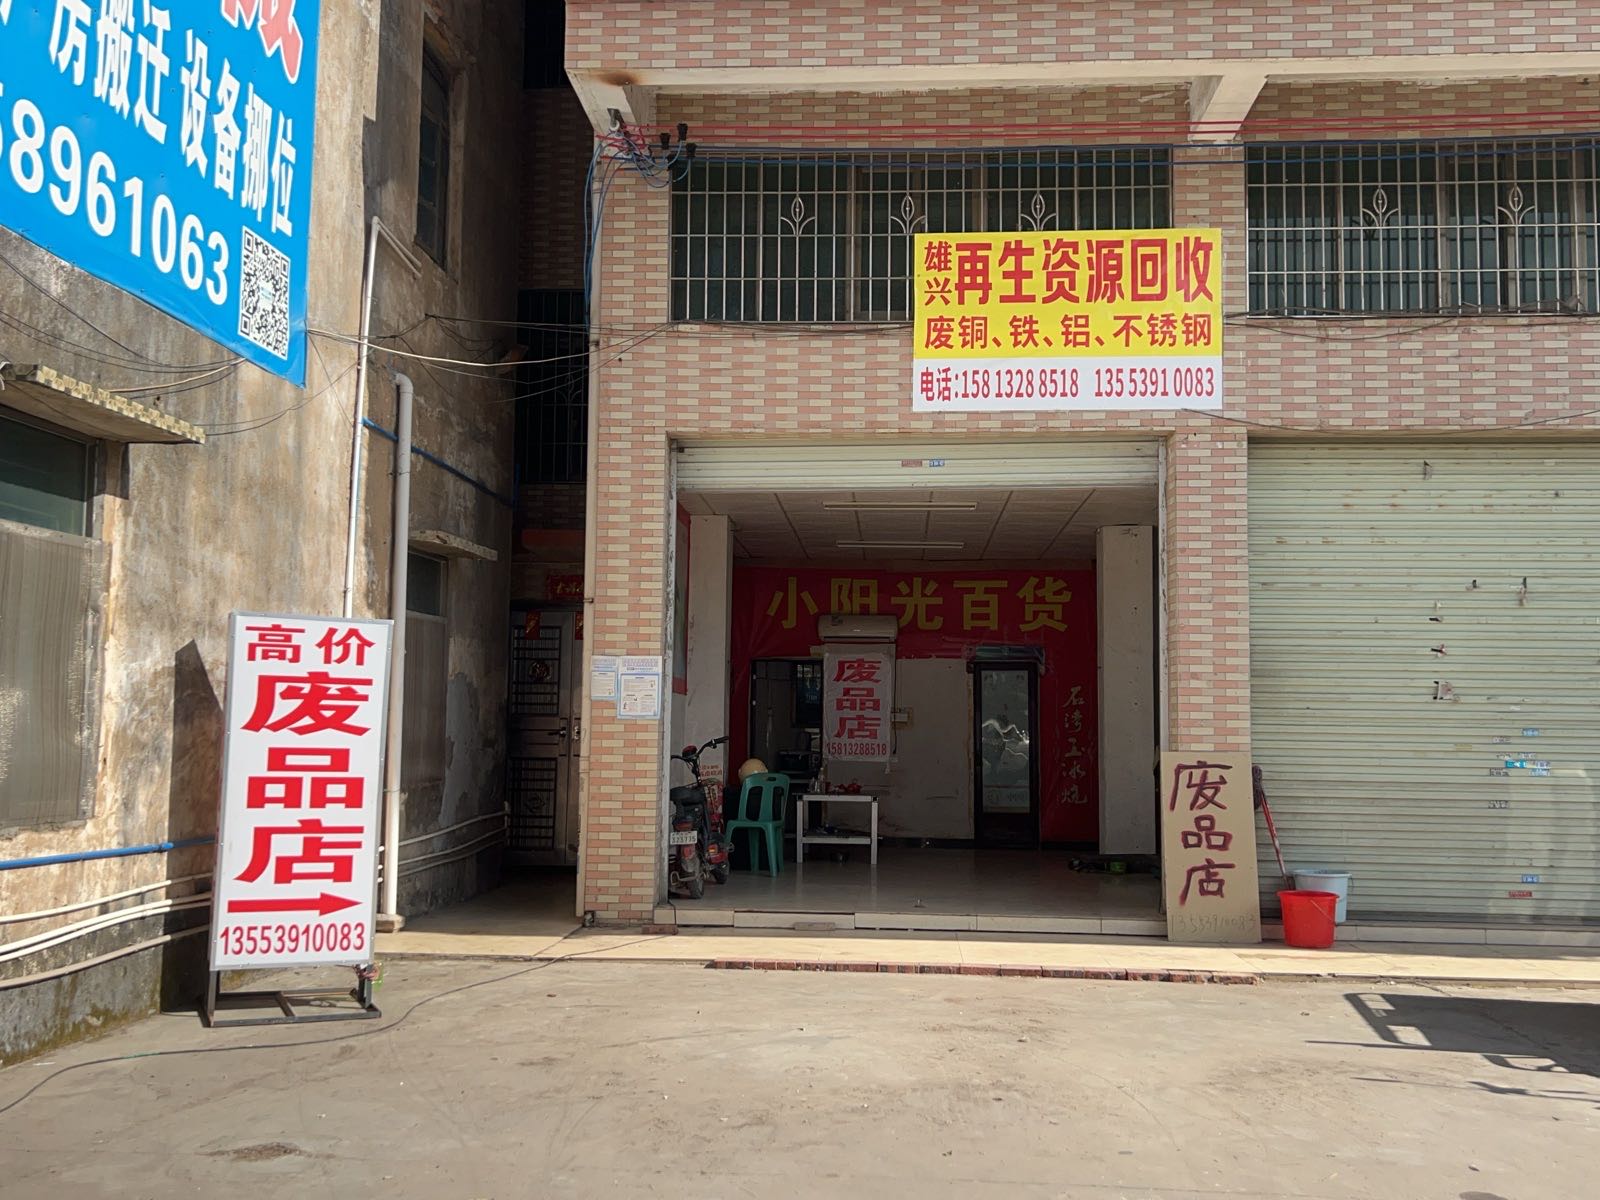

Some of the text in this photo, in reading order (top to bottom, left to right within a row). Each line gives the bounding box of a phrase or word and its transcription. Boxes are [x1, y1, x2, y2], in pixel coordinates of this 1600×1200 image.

[0, 0, 171, 145] 房搬迁
[181, 29, 296, 237] 设备挪位
[0, 82, 230, 306] 8961063
[955, 236, 1213, 306] 再生资源回收
[924, 312, 1212, 350] 废铜、铁、铝、不锈钢
[767, 576, 1073, 632] 小阳光百货
[245, 624, 376, 665] 高价
[833, 658, 882, 739] 废品店
[234, 671, 373, 885] 废品店
[826, 742, 887, 755] 15813288518
[1169, 760, 1236, 908] 废品店
[220, 922, 365, 955] 13553910083
